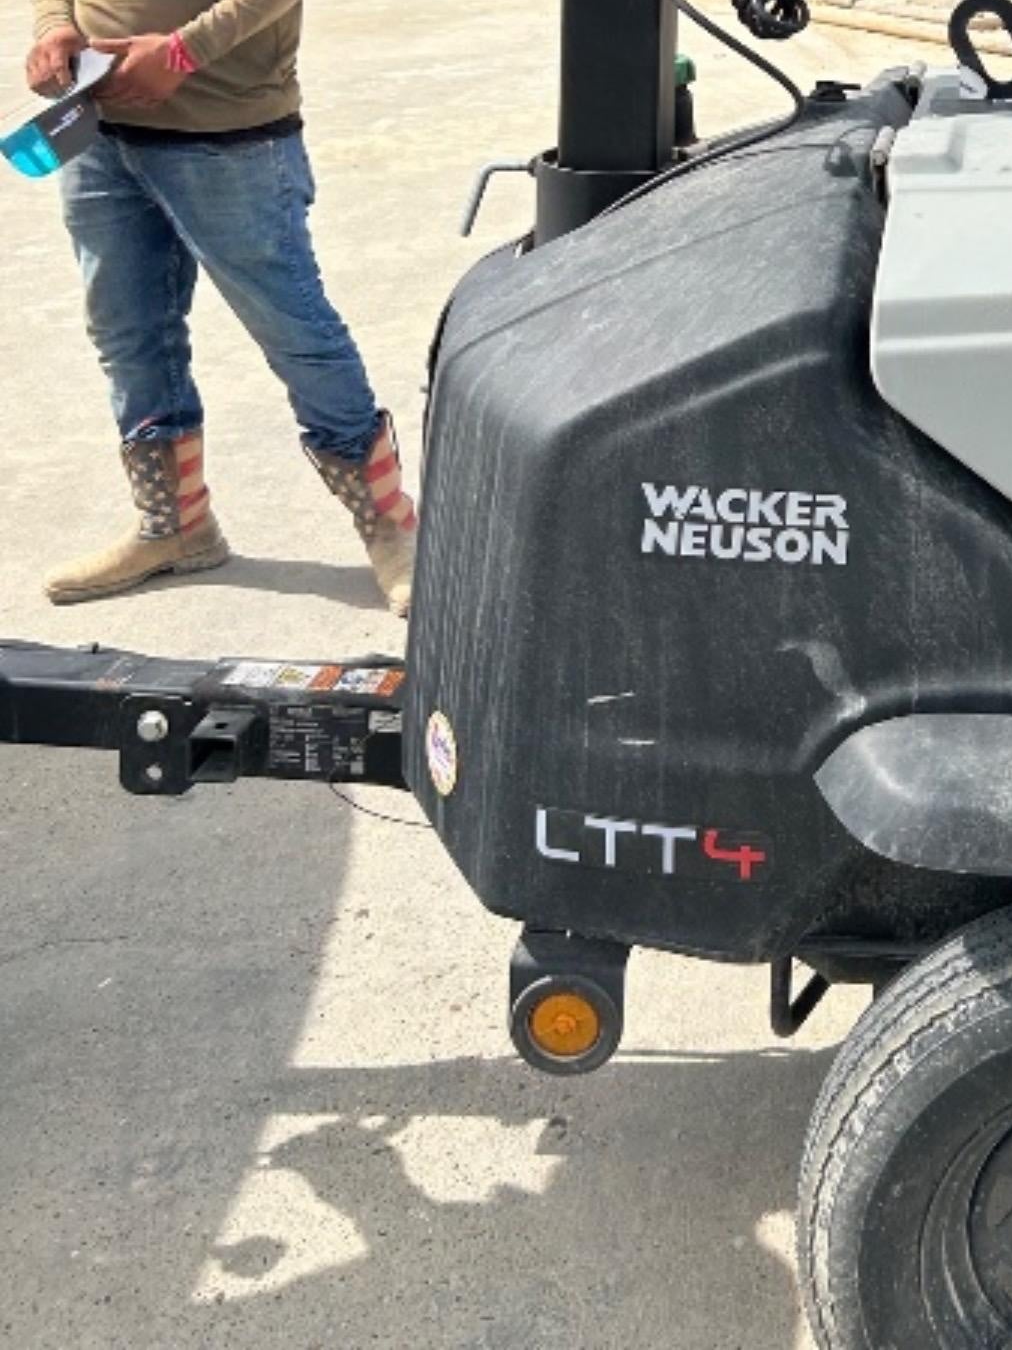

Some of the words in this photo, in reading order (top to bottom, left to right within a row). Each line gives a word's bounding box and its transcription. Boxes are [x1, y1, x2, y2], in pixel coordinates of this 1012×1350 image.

[641, 482, 849, 529] WACKER
[641, 518, 849, 565] NEUSON
[536, 807, 766, 879] LTT4
